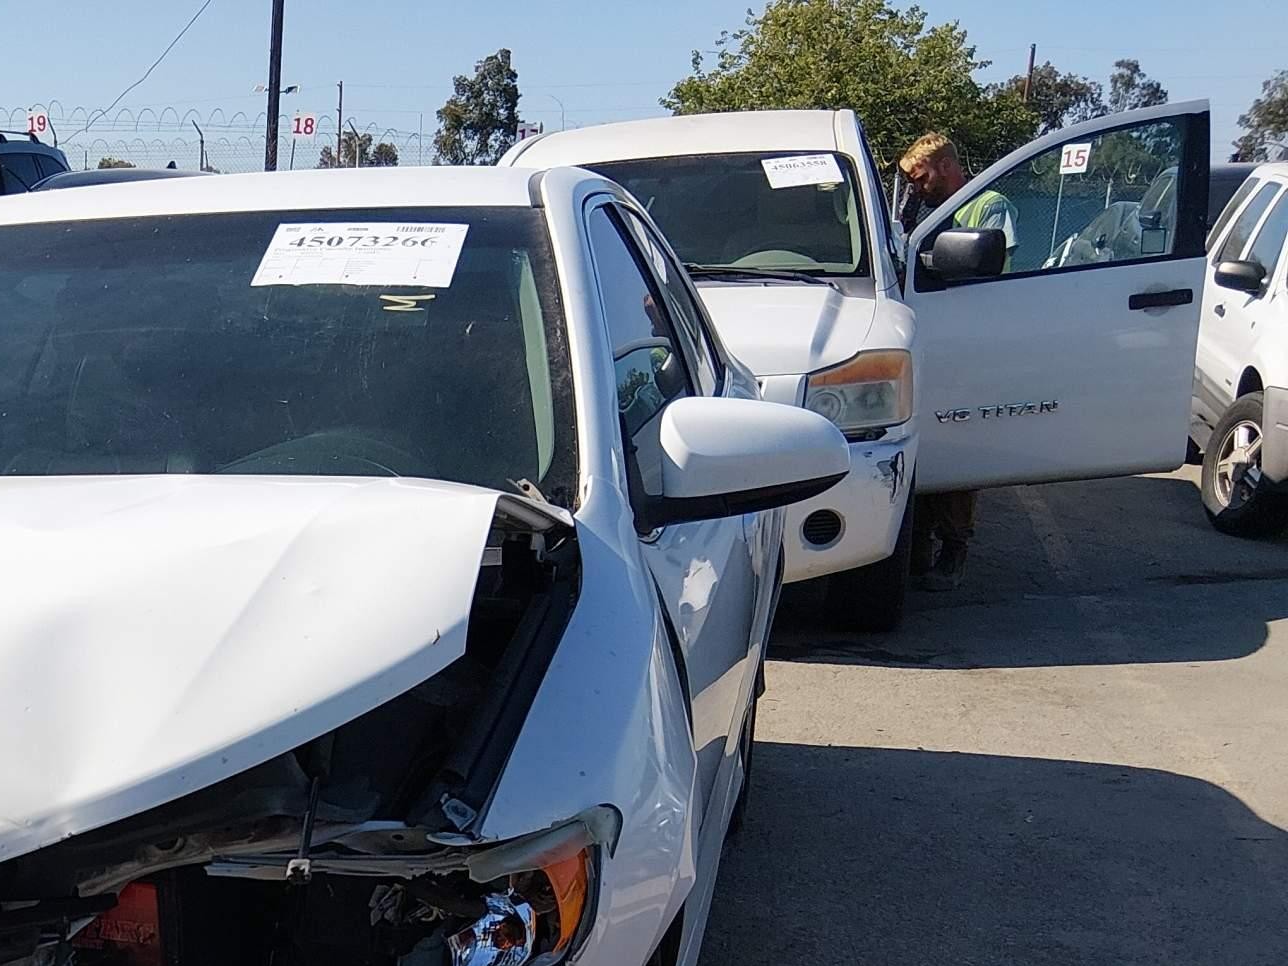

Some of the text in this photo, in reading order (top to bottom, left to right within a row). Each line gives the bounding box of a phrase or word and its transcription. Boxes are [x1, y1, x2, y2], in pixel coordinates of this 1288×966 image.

[28, 115, 46, 132] 19
[293, 117, 314, 135] 18
[1063, 149, 1087, 168] 15
[289, 236, 439, 248] 45073266
[978, 400, 1059, 419] TITAN
